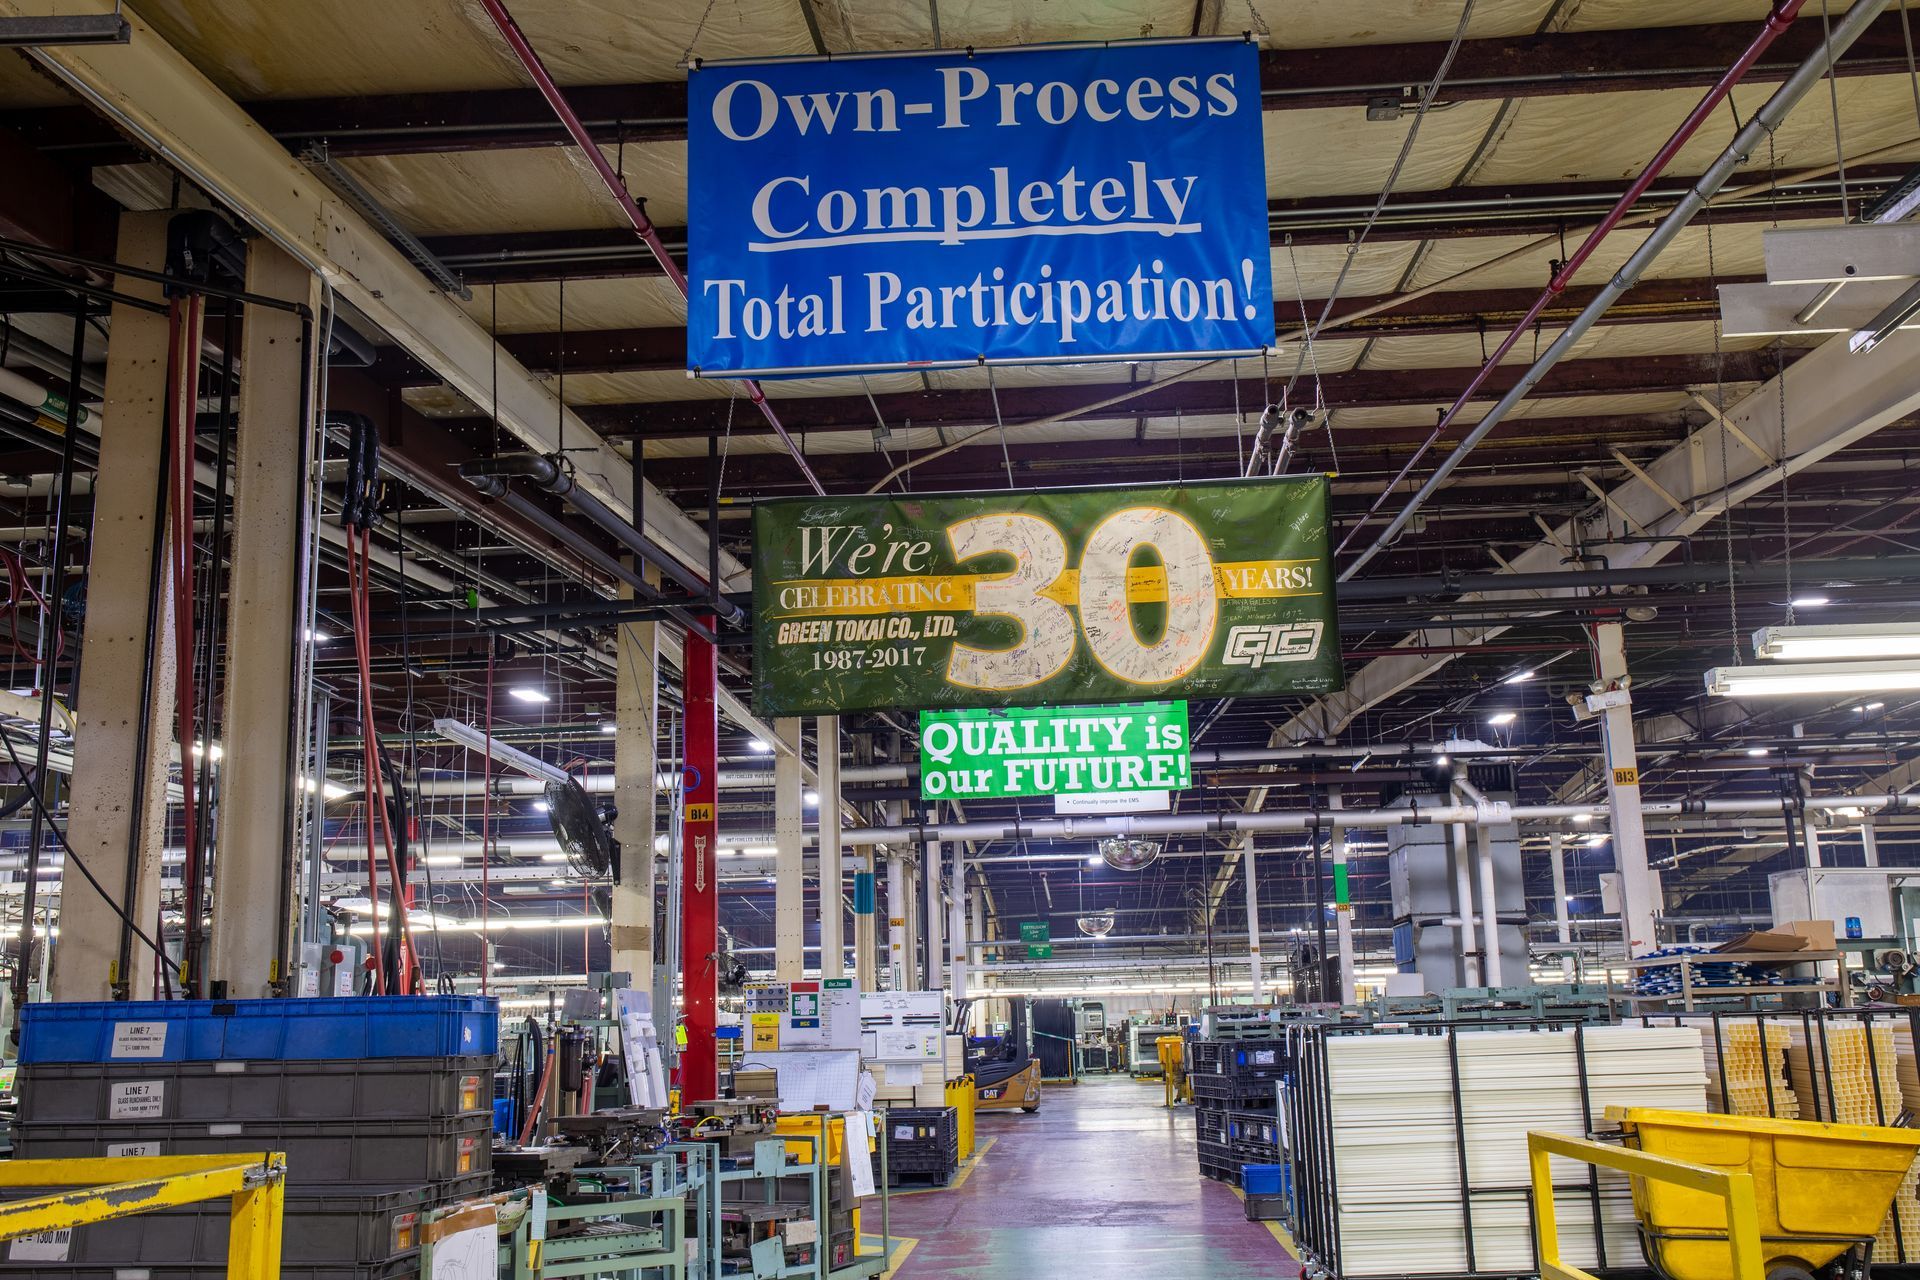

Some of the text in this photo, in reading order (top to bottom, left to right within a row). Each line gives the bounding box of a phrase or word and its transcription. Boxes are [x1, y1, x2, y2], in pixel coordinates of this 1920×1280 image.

[711, 67, 1239, 142] Own-Process
[751, 161, 1198, 245] Completely
[704, 258, 1257, 342] Total Participation!
[797, 523, 931, 576] We're
[1224, 566, 1312, 590] YEARS!
[780, 582, 952, 609] CELEBRATING
[946, 506, 1218, 691] 30
[778, 615, 958, 644] GREEN TOKAI CO., LTD.
[811, 647, 927, 671] 1987-2017
[923, 715, 1182, 764] QUALITY is
[925, 754, 1188, 794] our FUTURE!
[1615, 771, 1635, 783] B13
[130, 1026, 145, 1034] LINE
[125, 1085, 150, 1095] LINE 7
[983, 1089, 998, 1099] CAT
[121, 1147, 146, 1156] LINE 7
[37, 1231, 53, 1244] 1300
[54, 1230, 70, 1244] MM
